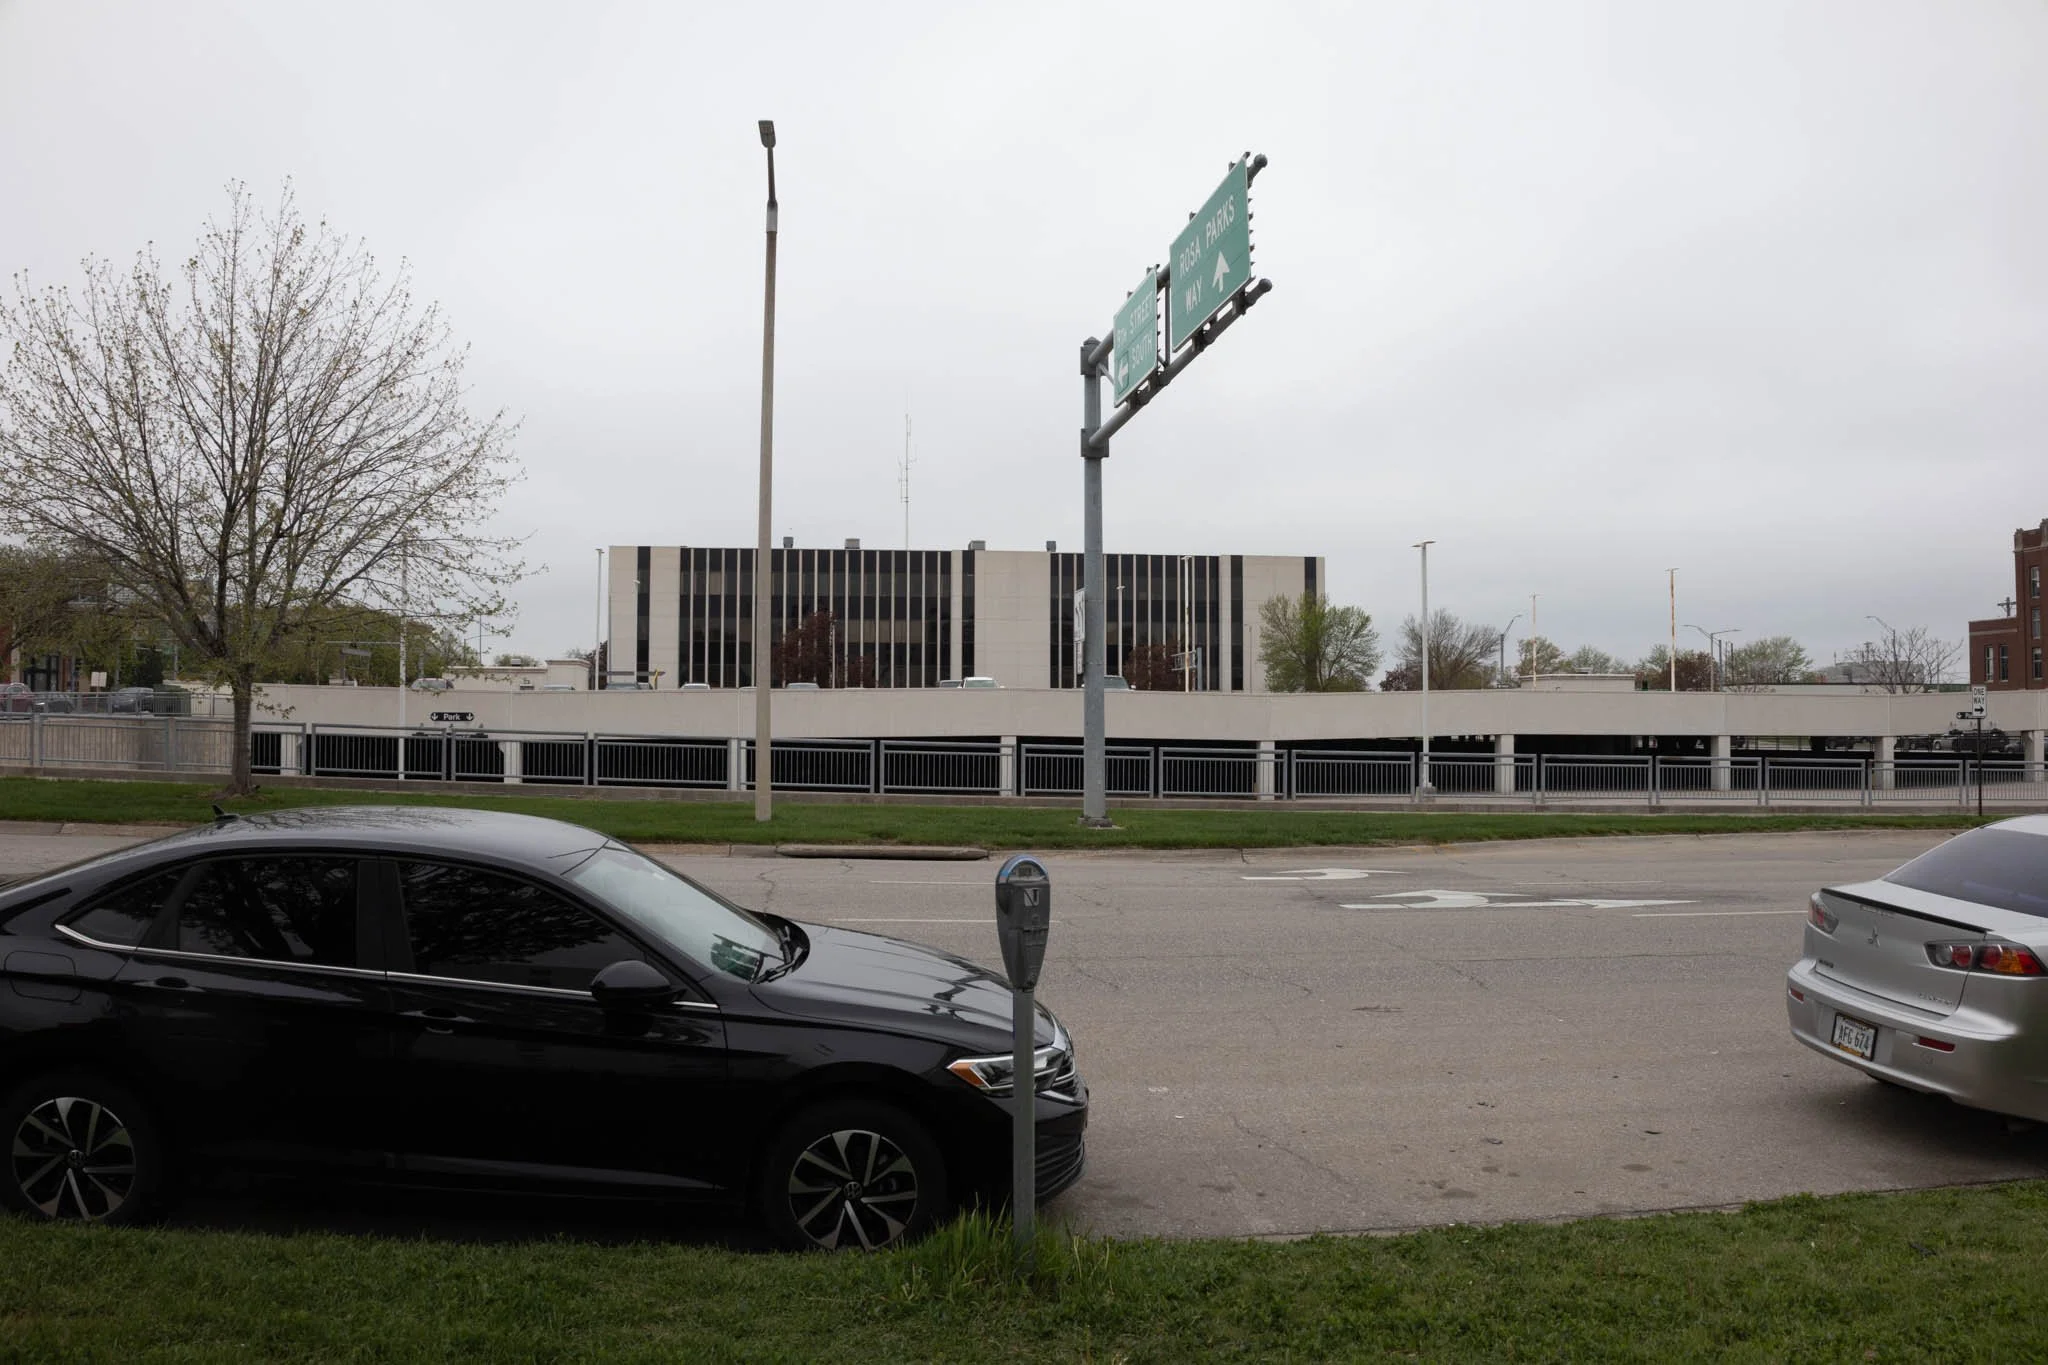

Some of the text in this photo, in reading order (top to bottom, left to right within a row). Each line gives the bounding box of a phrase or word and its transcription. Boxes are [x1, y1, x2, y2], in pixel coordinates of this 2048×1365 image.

[1180, 195, 1235, 279] ROSA PARKS
[1130, 291, 1153, 335] STREET
[1185, 275, 1202, 314] WAY
[1131, 330, 1152, 369] SOUTH
[1973, 687, 1985, 696] ONE
[1973, 697, 1985, 705] WAY
[443, 713, 460, 721] Park
